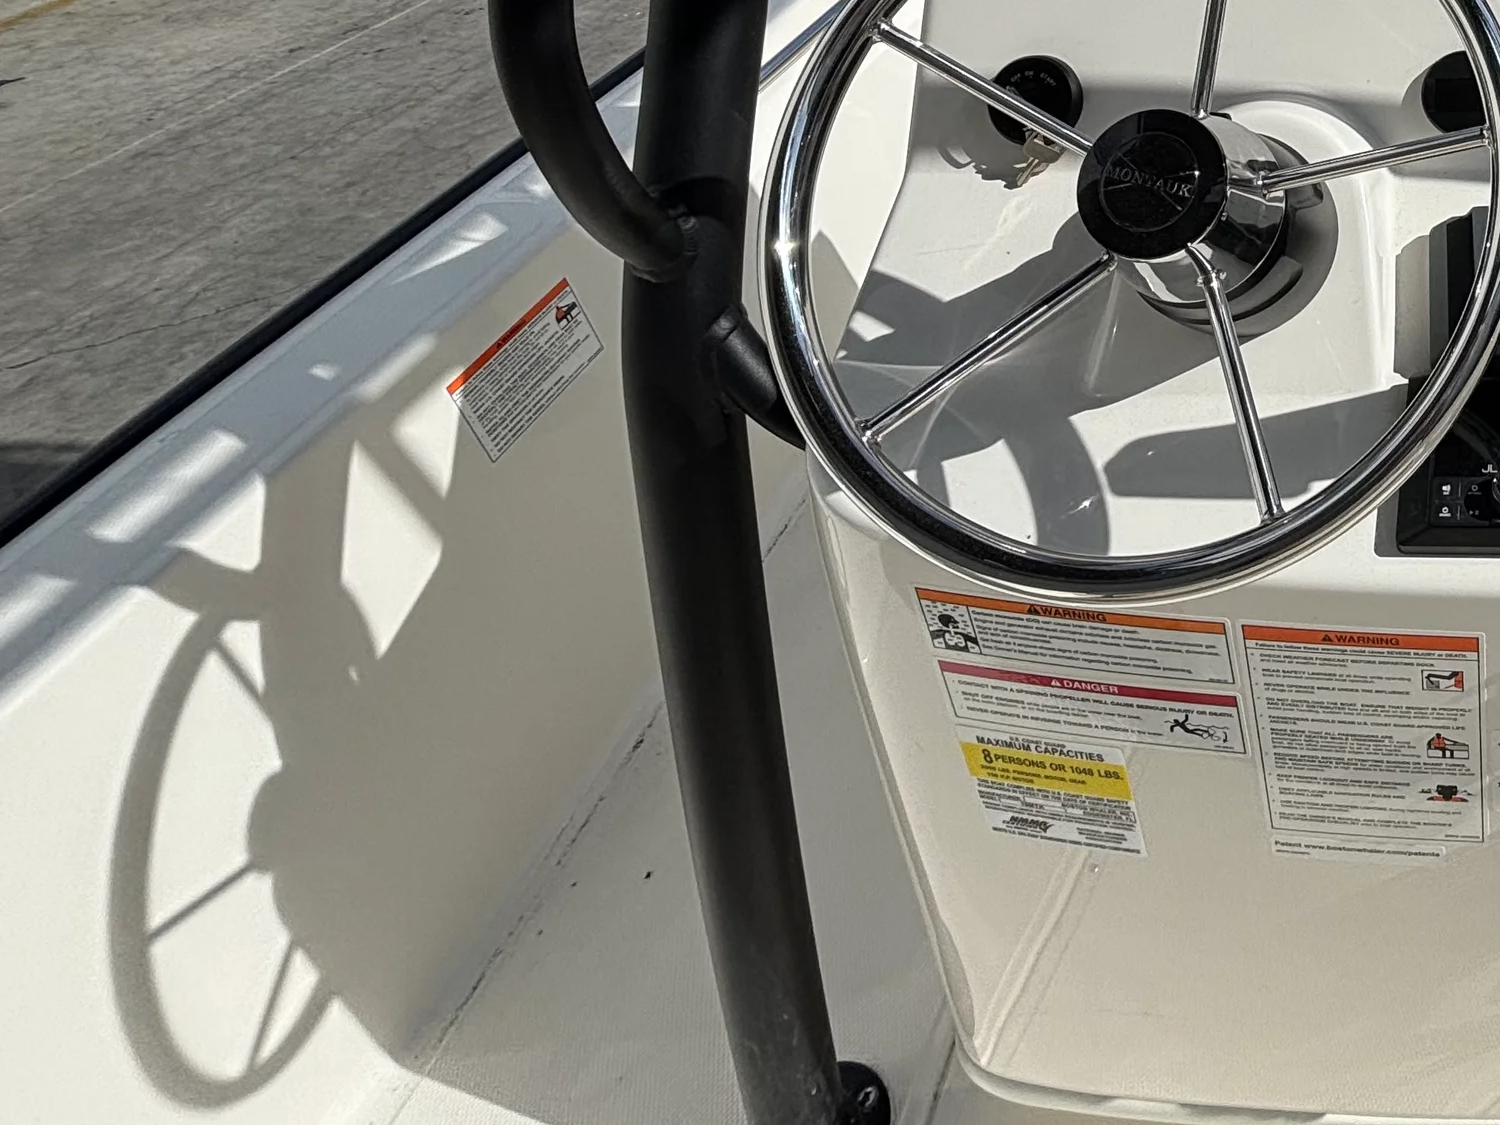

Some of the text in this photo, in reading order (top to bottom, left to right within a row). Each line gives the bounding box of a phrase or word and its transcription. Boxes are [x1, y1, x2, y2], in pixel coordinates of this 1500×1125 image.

[1106, 165, 1195, 198] MONTAUK
[1482, 464, 1498, 474] JL
[1040, 606, 1106, 622] WARNING
[1335, 634, 1400, 646] WARNING
[1063, 678, 1118, 694] DANGER
[976, 736, 1105, 762] MAXIMUM CAPACITIES
[980, 748, 994, 764] 8
[994, 753, 1046, 769] PERSONS
[1048, 762, 1066, 772] OR
[1097, 768, 1123, 780] LBS.
